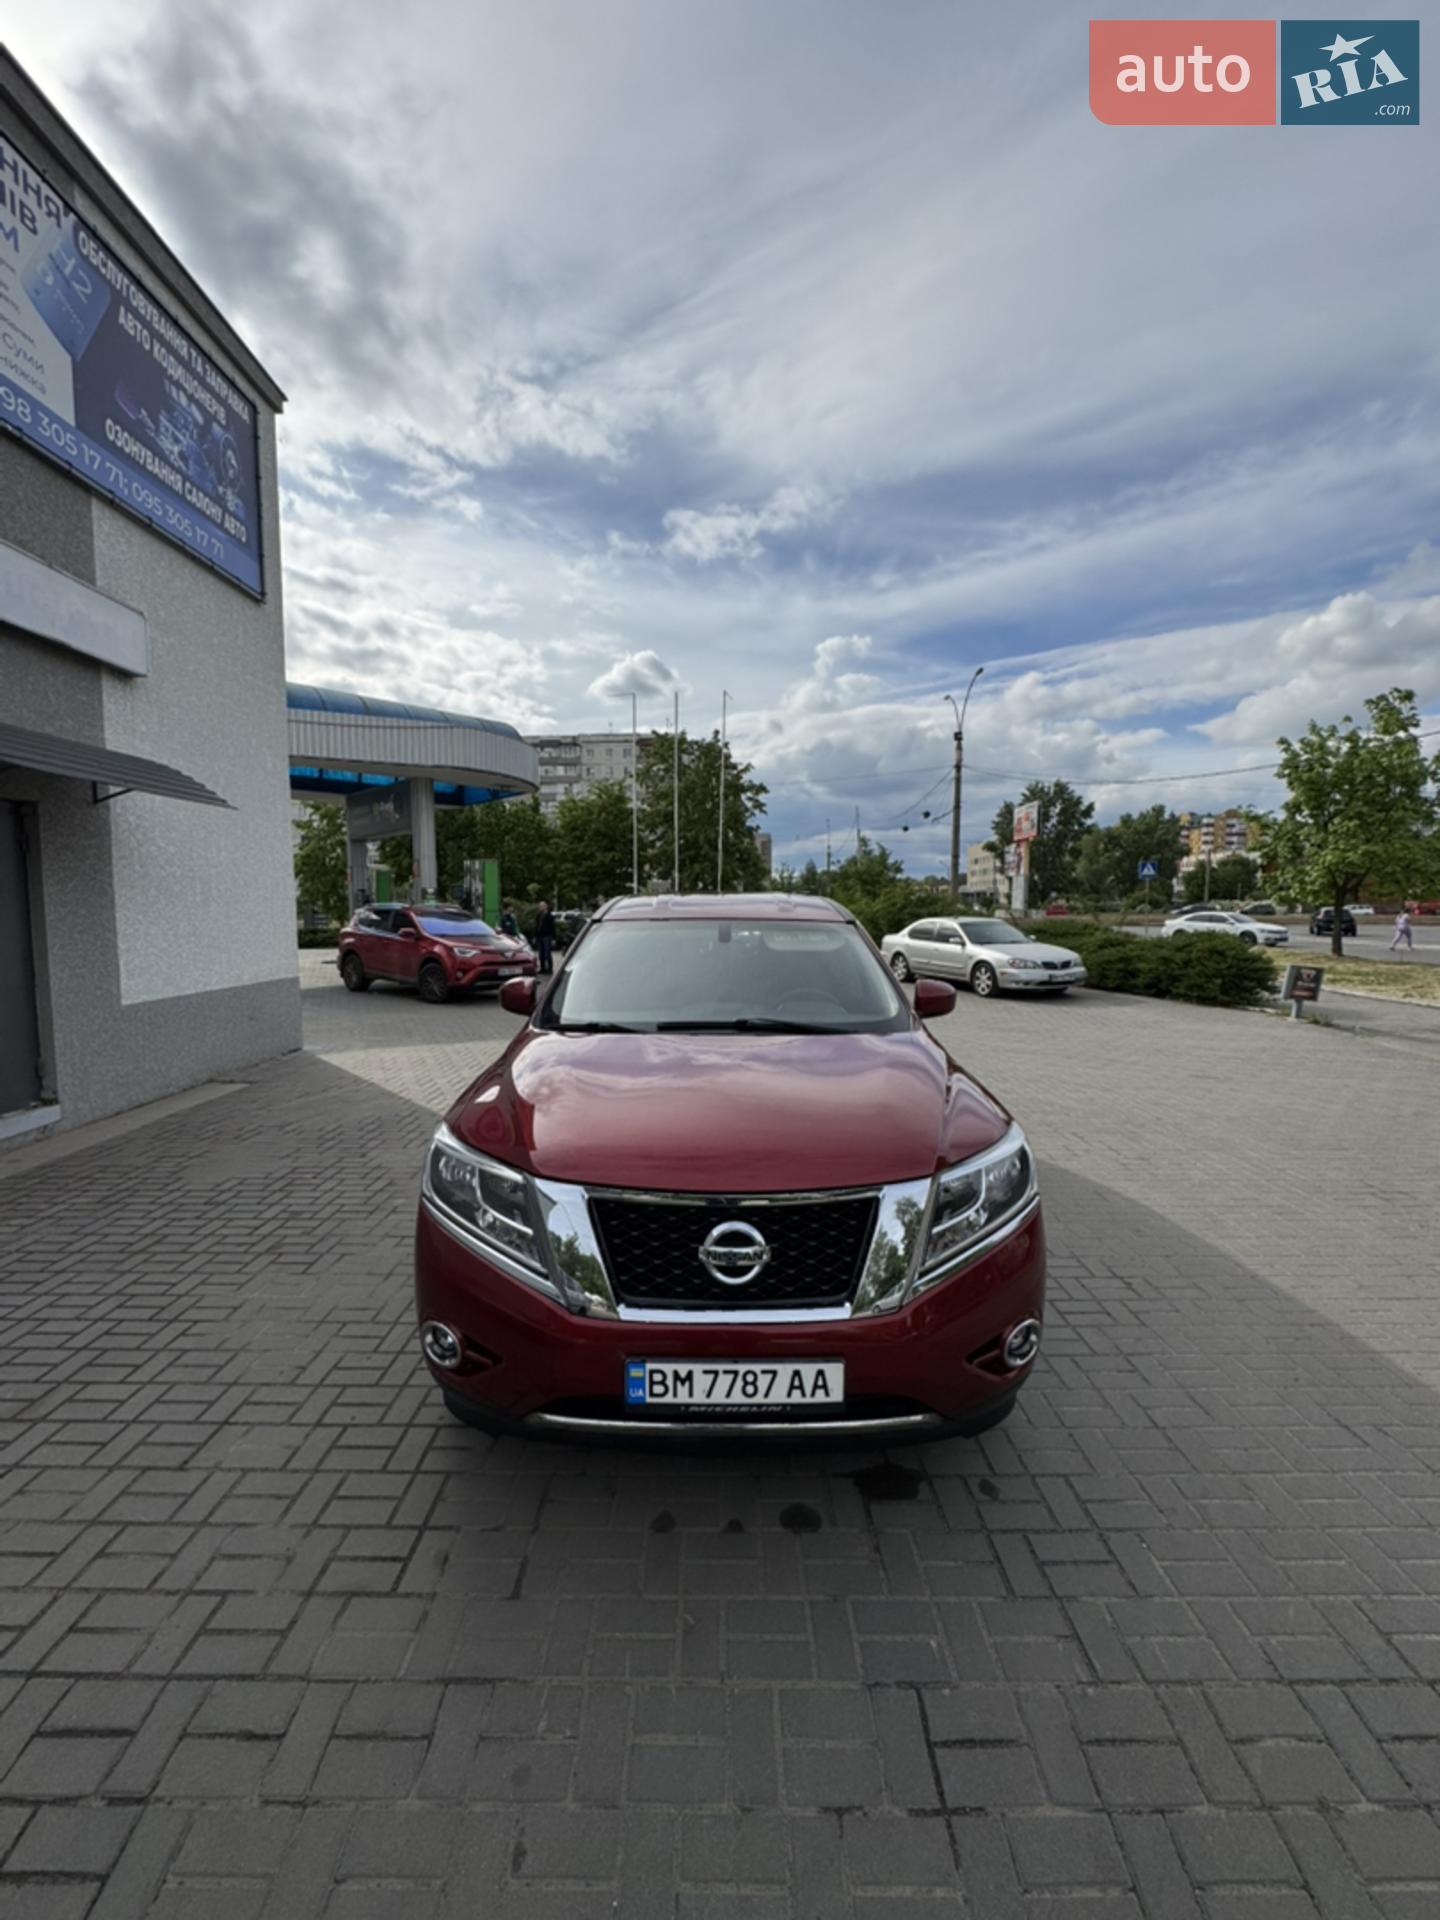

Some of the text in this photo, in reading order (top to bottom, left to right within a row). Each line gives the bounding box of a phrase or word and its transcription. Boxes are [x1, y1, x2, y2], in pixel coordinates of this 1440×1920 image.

[78, 230, 189, 361] ОБСЛУГОВУВАННЯ
[118, 304, 151, 352] АВТО
[37, 411, 78, 456] 305
[81, 443, 102, 471] 17
[131, 481, 163, 517] 095
[165, 505, 193, 538] 305
[194, 525, 209, 547] 17
[211, 537, 226, 560] 71
[105, 417, 247, 543] ОЗОНУВАННЯ САЛОНУ АВТО
[629, 1388, 644, 1398] UA
[648, 1369, 830, 1399] BM 7787 AA
